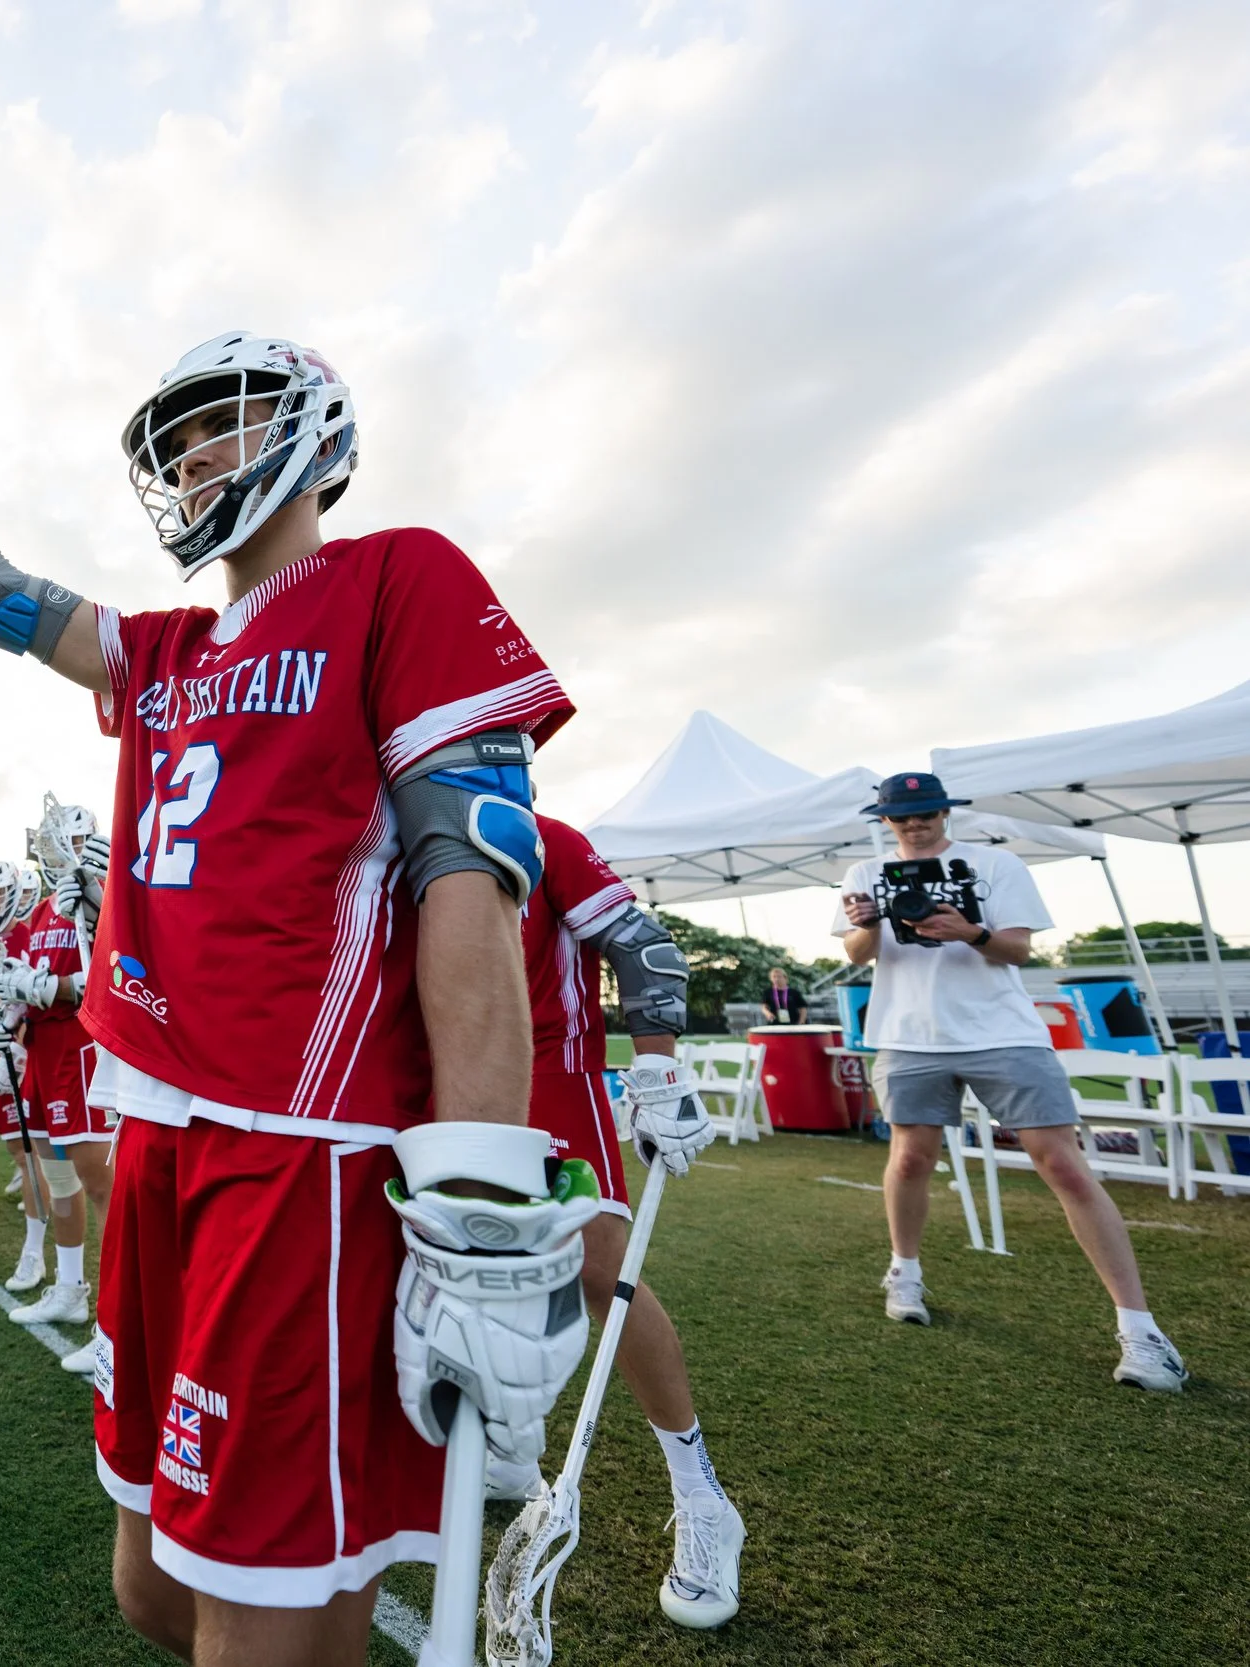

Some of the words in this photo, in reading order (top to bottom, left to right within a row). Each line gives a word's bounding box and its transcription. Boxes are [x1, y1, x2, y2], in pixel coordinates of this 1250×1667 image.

[125, 979, 168, 1016] CSG
[665, 1070, 678, 1085] 11
[172, 1372, 229, 1421] BRITAIN
[581, 1420, 595, 1448] UNION
